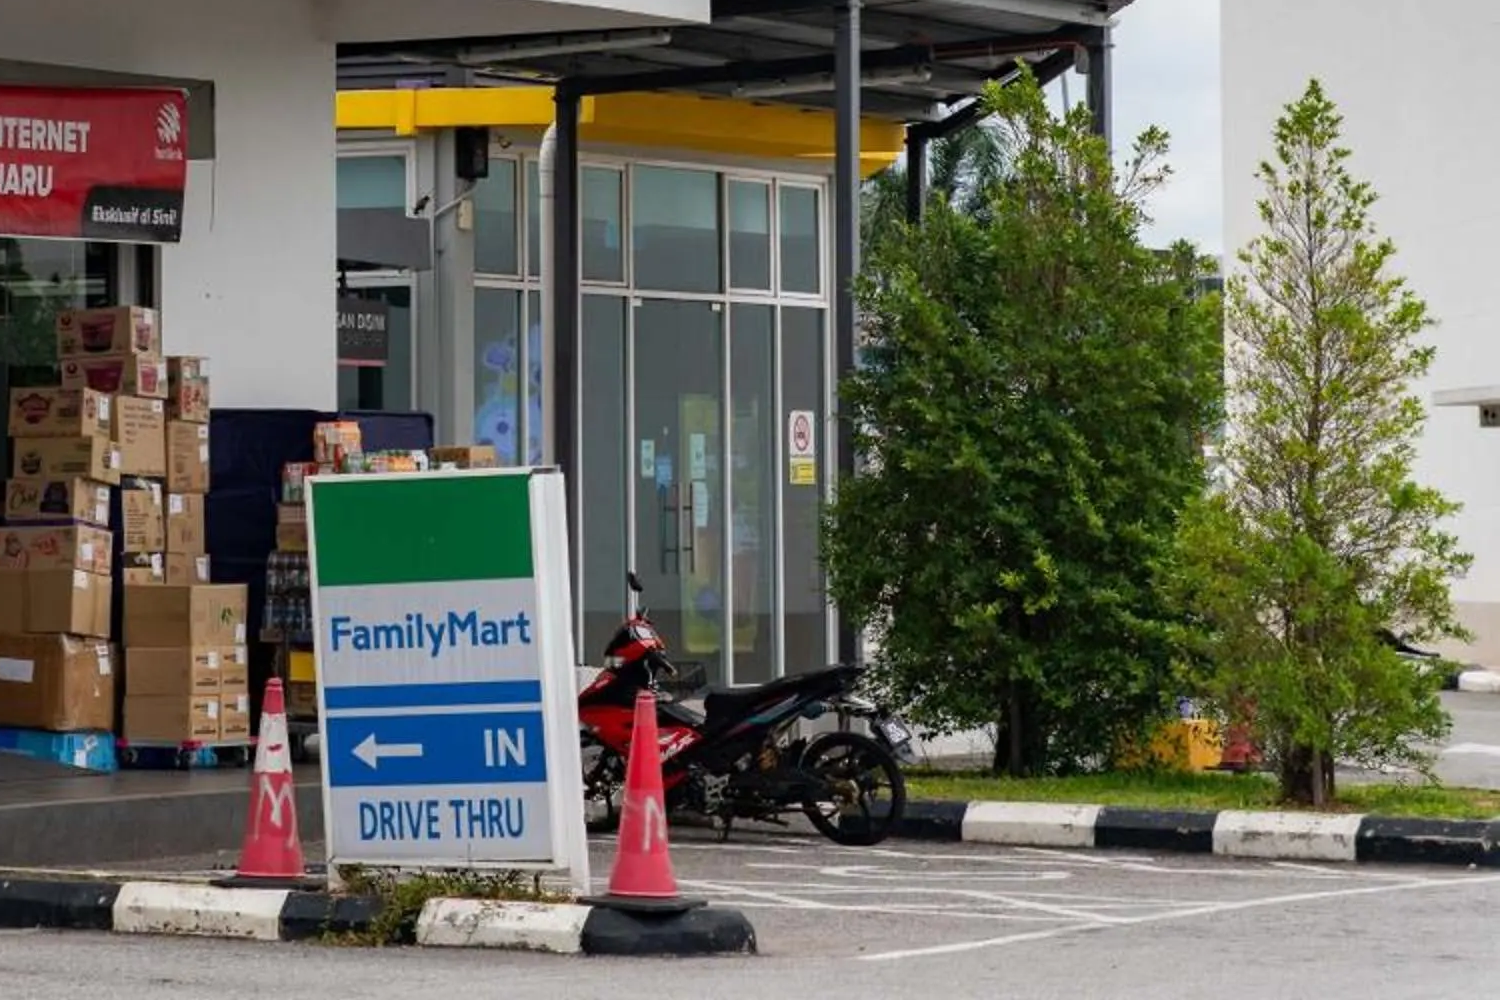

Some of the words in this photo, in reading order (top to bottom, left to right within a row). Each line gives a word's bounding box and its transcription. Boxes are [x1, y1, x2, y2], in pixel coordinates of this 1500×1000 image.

[331, 610, 531, 658] FamilyMart
[483, 727, 527, 768] IN
[359, 799, 441, 842] DRIVE
[449, 797, 525, 840] THRU
